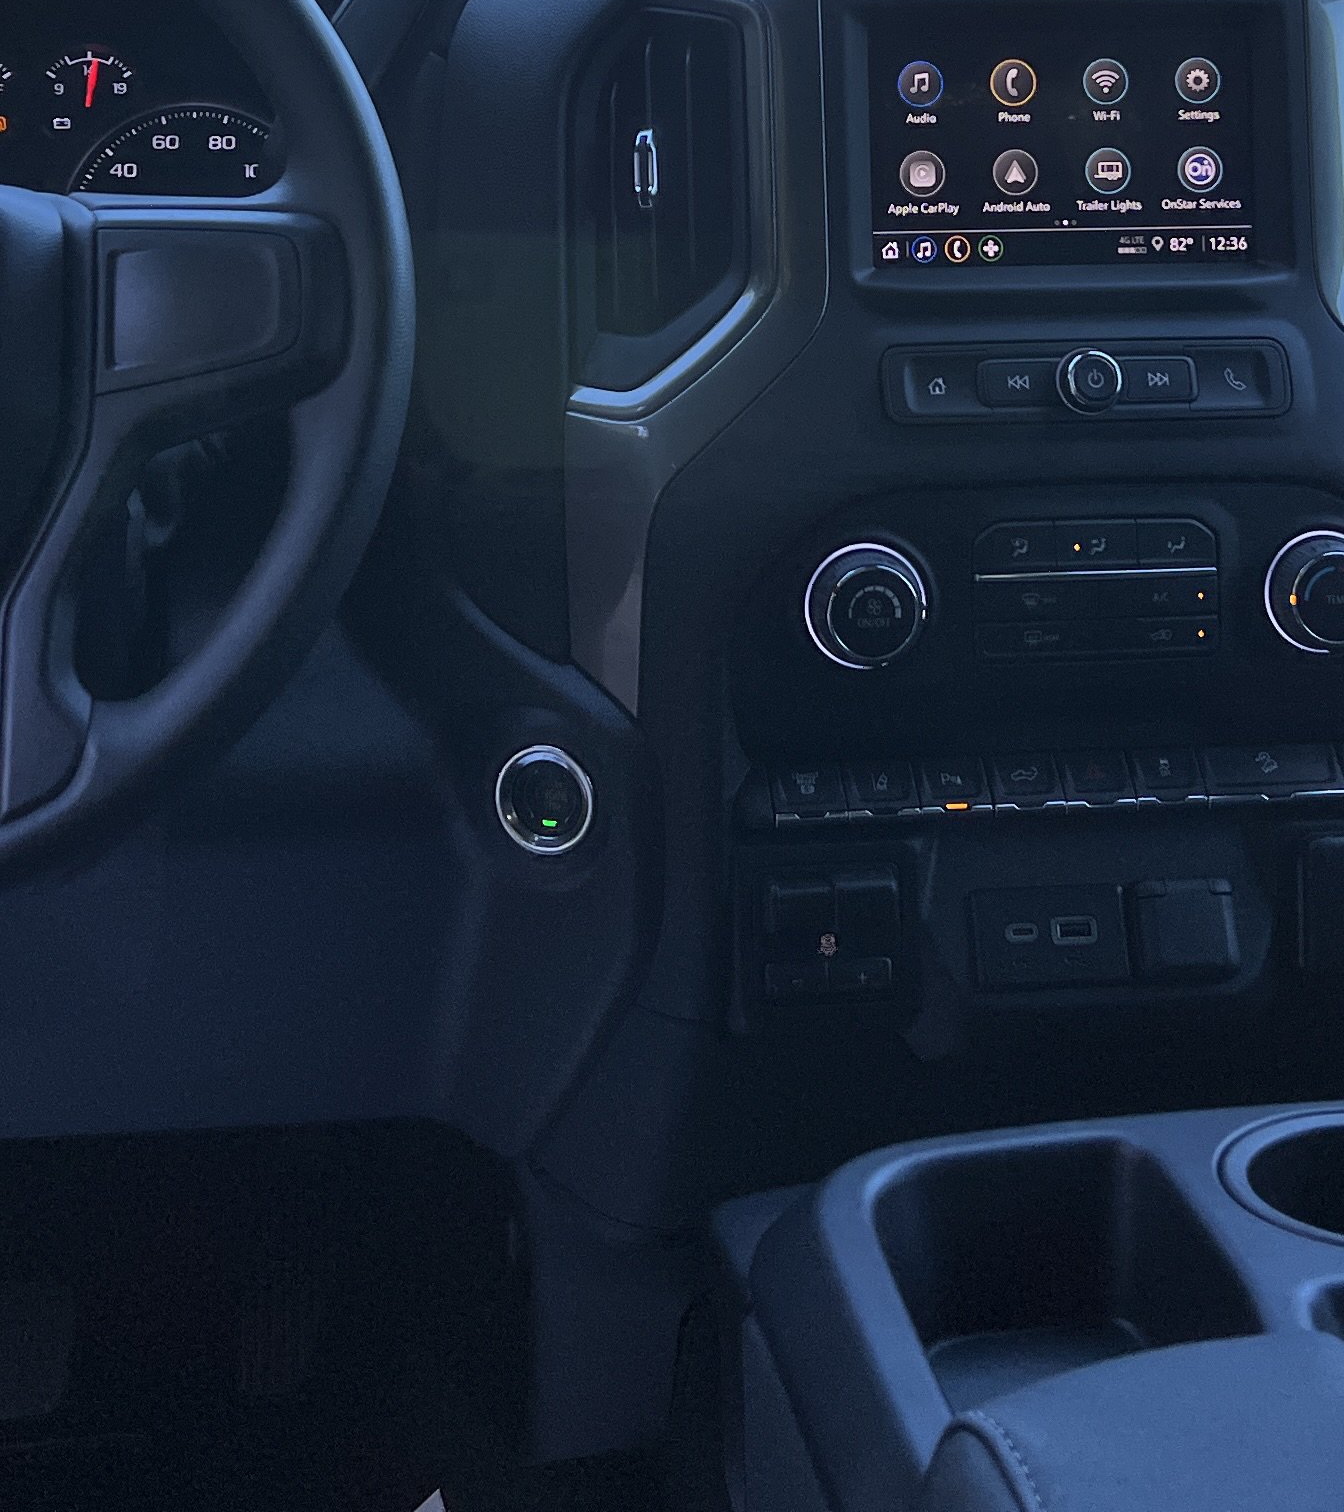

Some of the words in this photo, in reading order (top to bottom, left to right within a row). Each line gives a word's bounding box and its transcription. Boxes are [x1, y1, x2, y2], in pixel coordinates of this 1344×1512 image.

[53, 83, 65, 96] 9
[112, 83, 128, 95] 19
[905, 113, 938, 124] Audio
[998, 111, 1031, 123] Phone
[1092, 110, 1121, 121] Wi-Fi
[1177, 109, 1221, 123] Settings
[151, 135, 180, 150] 60
[208, 135, 237, 150] 80
[109, 163, 138, 178] 40
[887, 203, 919, 217] Apple
[920, 202, 960, 217] CarPlay
[982, 201, 1024, 213] Android
[1025, 201, 1051, 213] Auto
[1076, 199, 1109, 211] Trailer
[1110, 199, 1143, 213] Lights
[1161, 199, 1197, 210] OnStar
[1199, 198, 1242, 210] Services
[1119, 236, 1131, 244] 4G
[1131, 235, 1145, 244] LTE
[1209, 236, 1248, 251] 12:36
